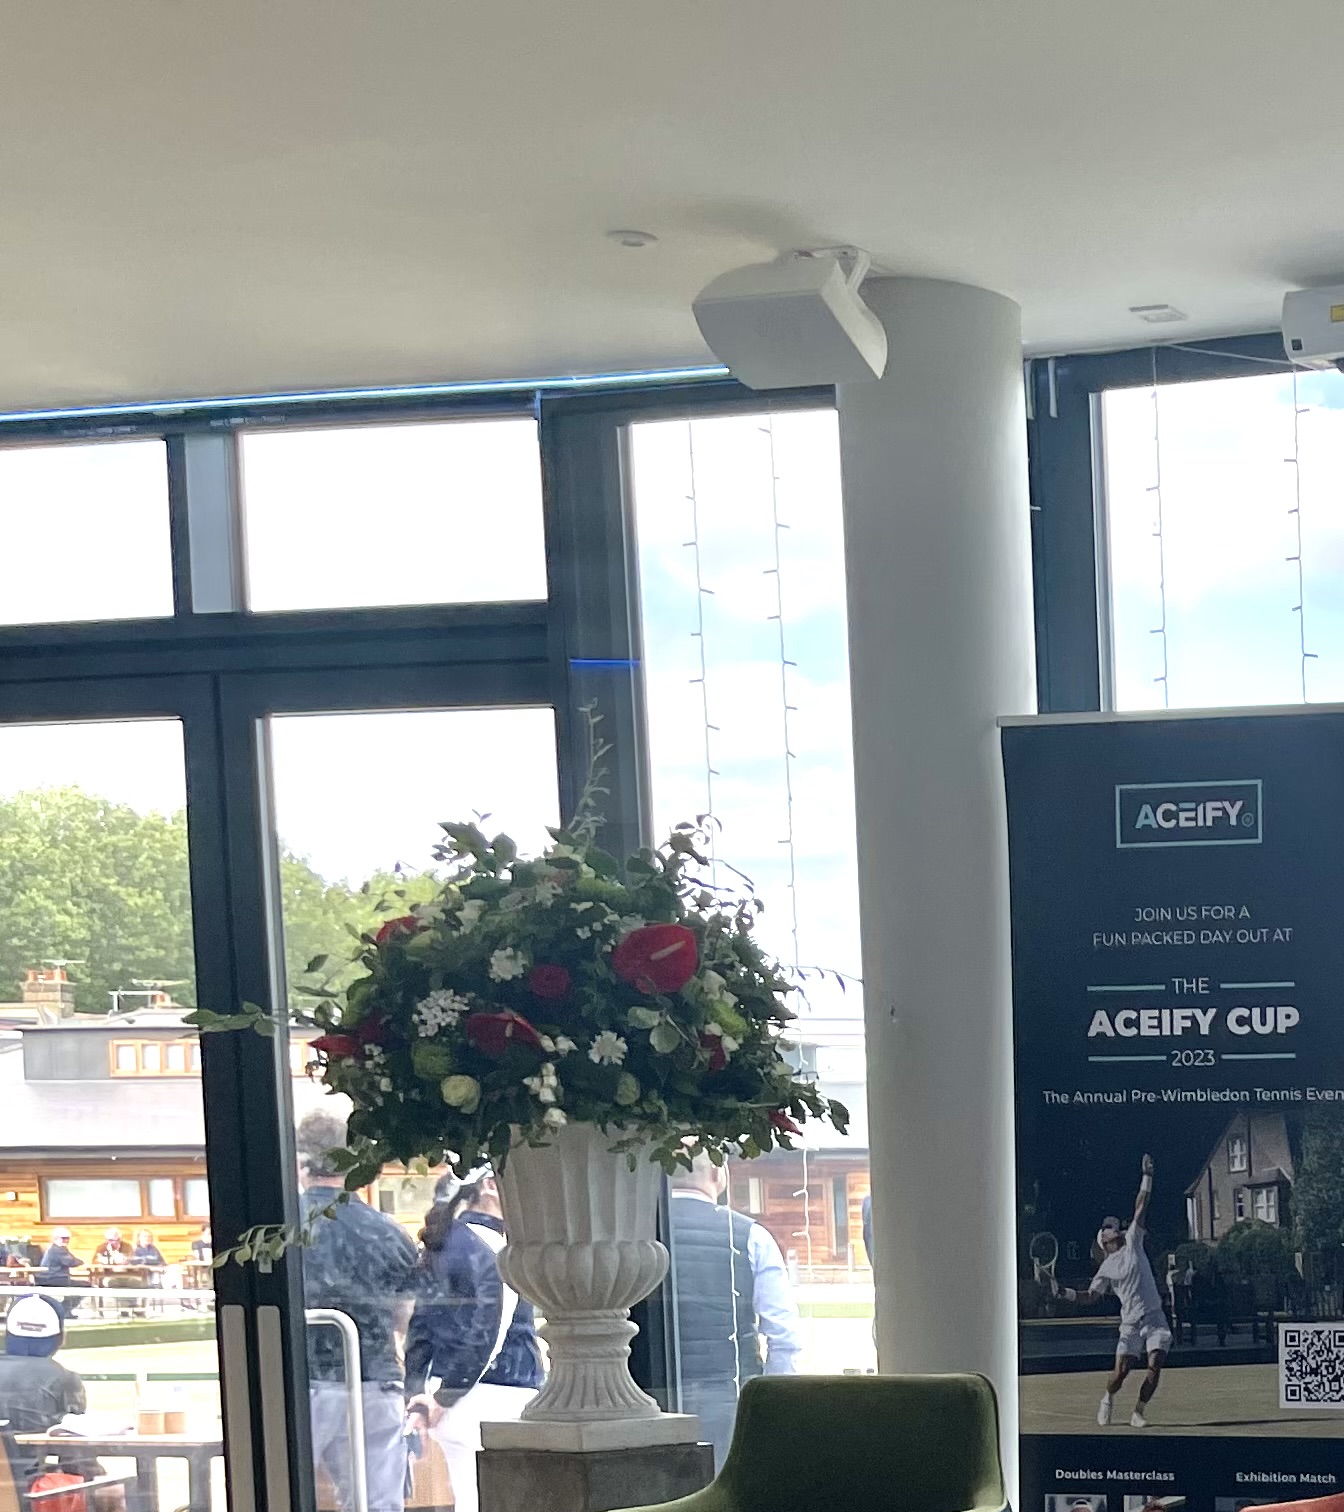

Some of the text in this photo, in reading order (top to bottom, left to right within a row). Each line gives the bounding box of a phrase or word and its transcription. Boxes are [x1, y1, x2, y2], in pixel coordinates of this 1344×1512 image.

[1134, 905, 1251, 921] JOIN US FOR A
[1093, 928, 1293, 946] FUN PACKED DAY OUT AT
[1171, 978, 1209, 994] THE
[1087, 1007, 1300, 1037] ACEIFY CUP
[1171, 1050, 1215, 1066] 2023
[1043, 1091, 1069, 1103] The
[1073, 1090, 1126, 1103] Annual
[1132, 1089, 1249, 1102] Pre-Wimbledon
[1255, 1088, 1301, 1101] Tennis
[1056, 1469, 1174, 1481] Doubles Masterclass
[1236, 1472, 1335, 1484] Exhibition Match
